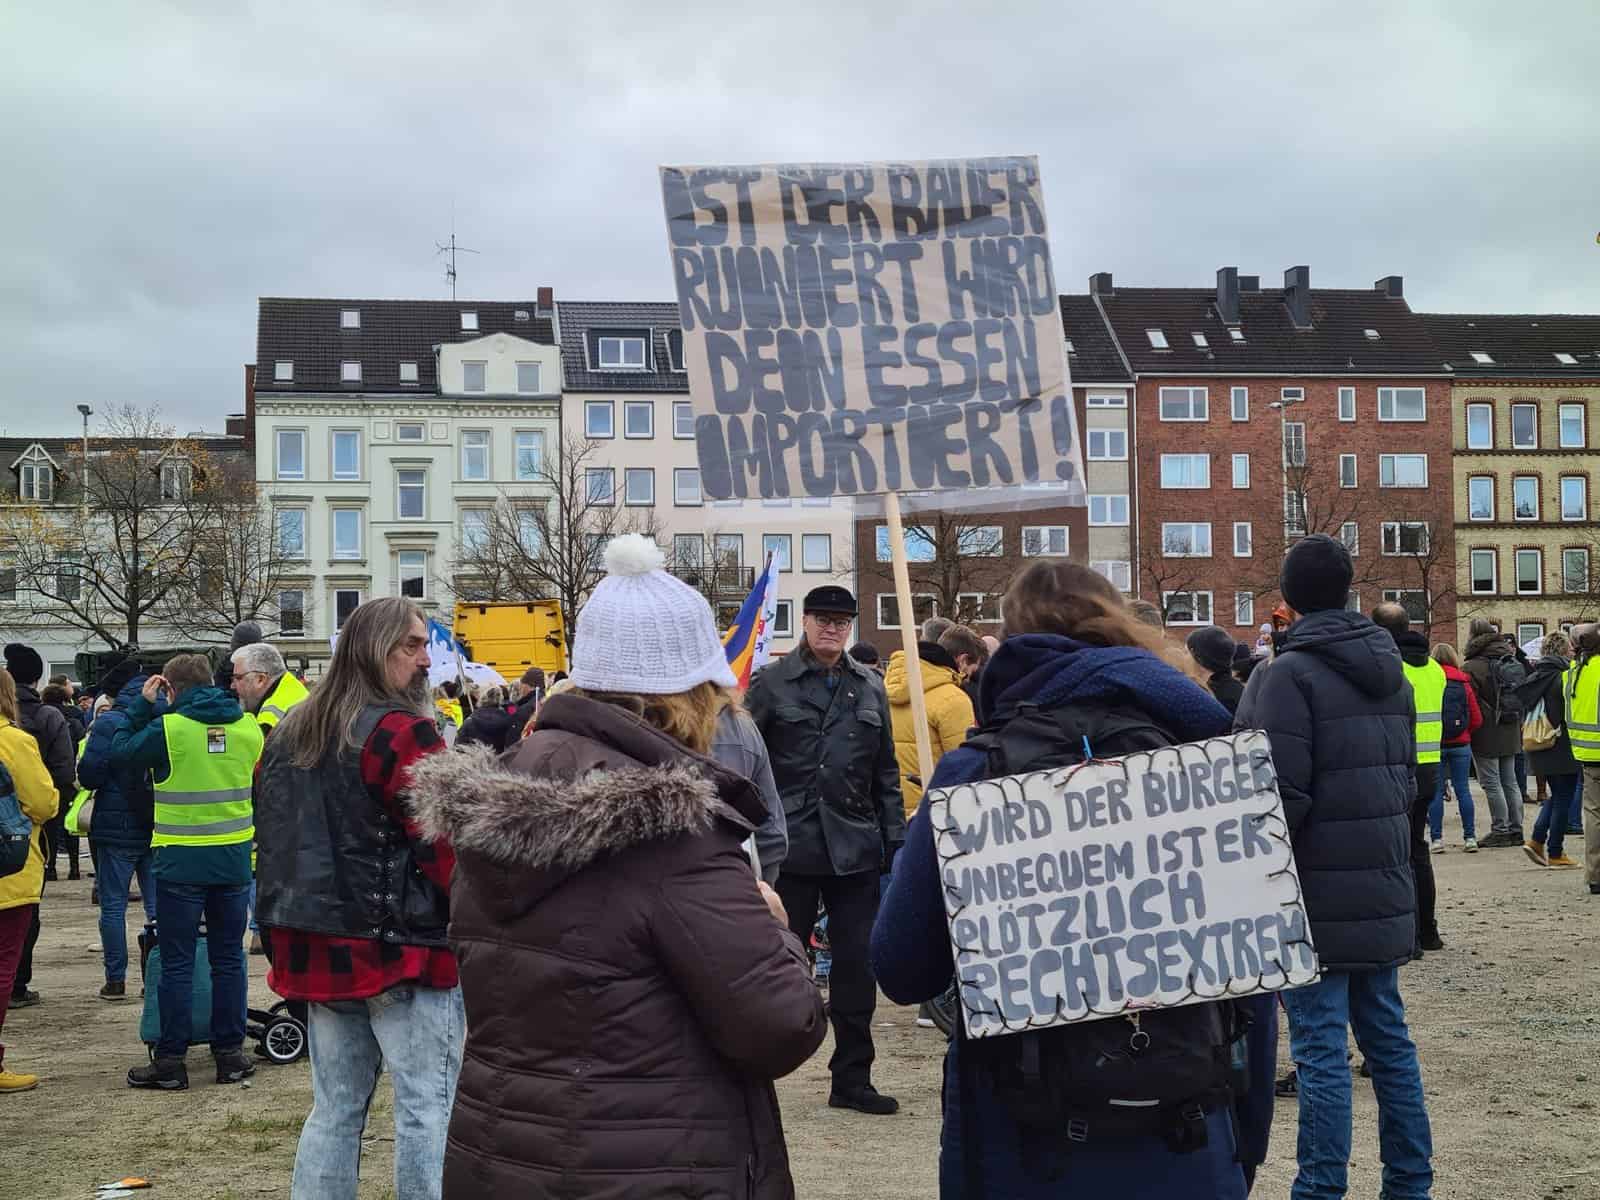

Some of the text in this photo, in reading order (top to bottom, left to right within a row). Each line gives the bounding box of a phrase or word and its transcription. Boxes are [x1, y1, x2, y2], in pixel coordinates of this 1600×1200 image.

[664, 159, 1045, 246] IST DER BAUER
[673, 236, 1056, 331] RUINIERT WIRD
[705, 317, 1040, 414] DEIN ESSEN
[696, 395, 1074, 498] IMPORTIERT!
[945, 749, 1276, 854] WIRD DER BÜRGER
[946, 813, 1273, 908] UNBEQUEM IST ER
[955, 870, 1206, 964] PLÖTZLICH
[962, 910, 1313, 1028] RECHTSEXTREM
